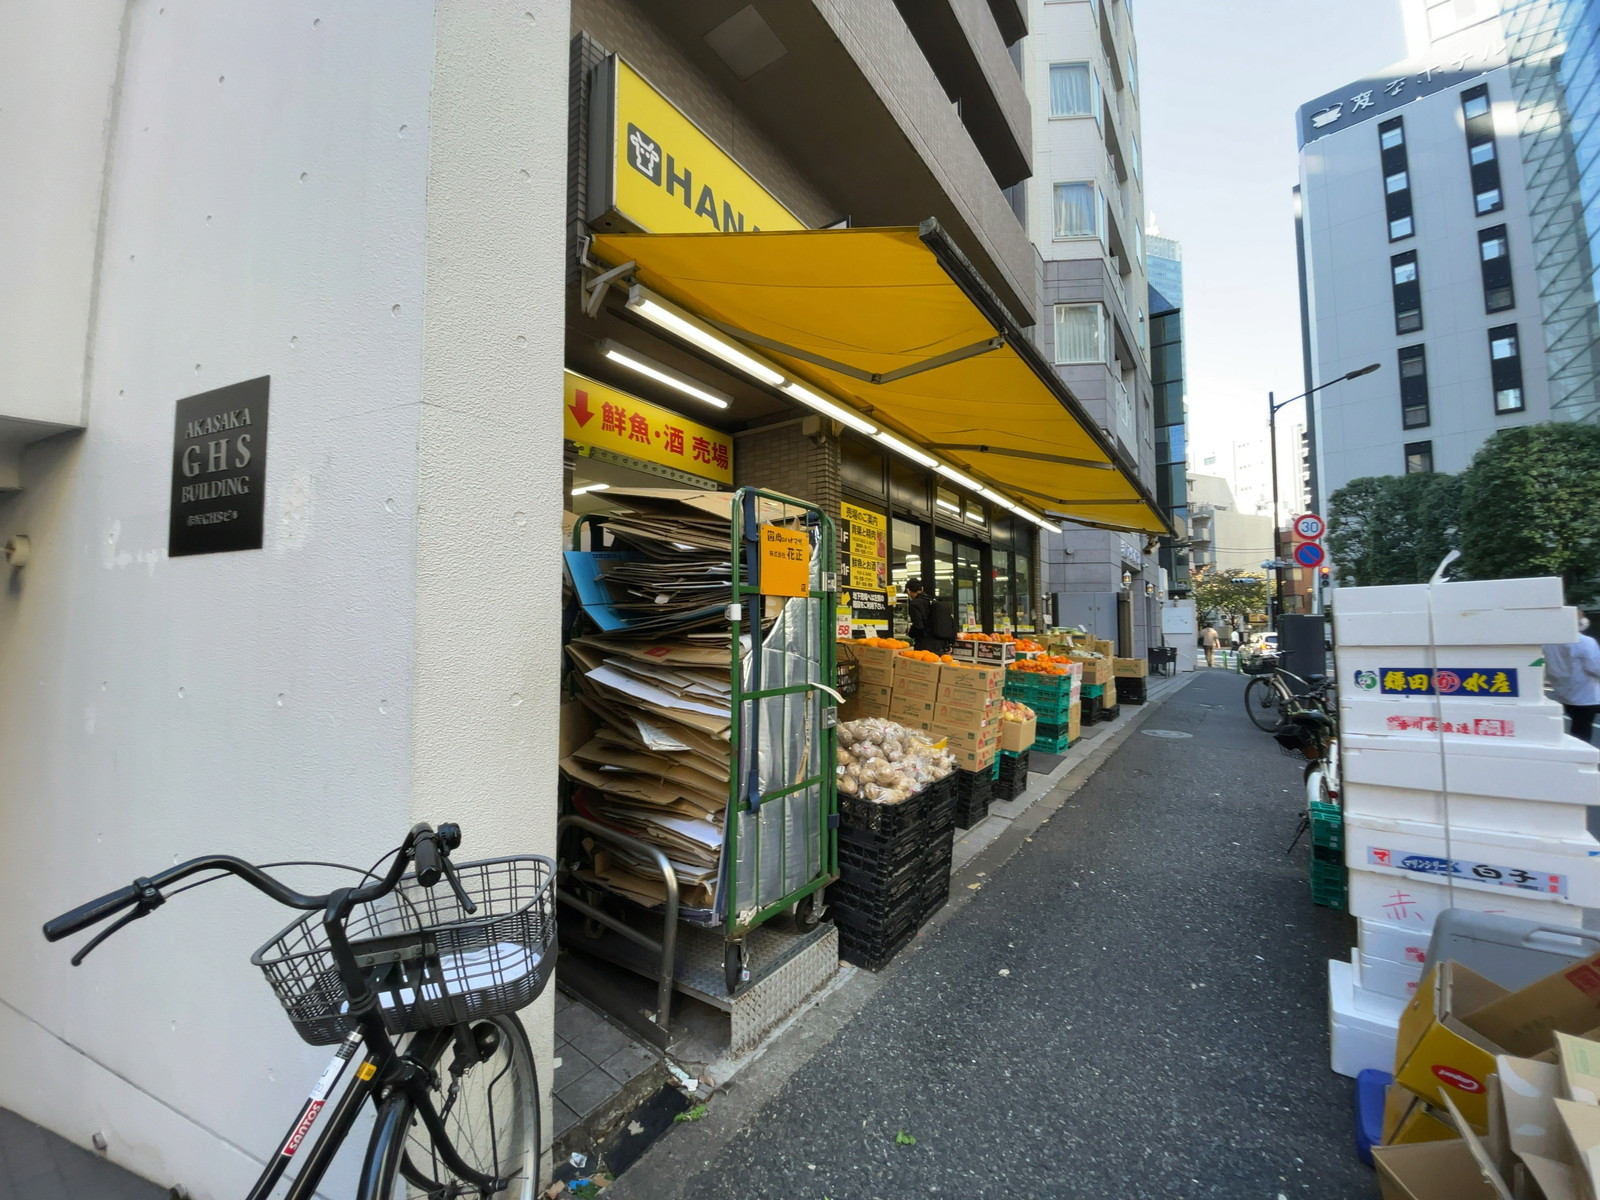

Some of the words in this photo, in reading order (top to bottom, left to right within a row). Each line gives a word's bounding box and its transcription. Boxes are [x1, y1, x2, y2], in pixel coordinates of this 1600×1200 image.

[184, 407, 252, 439] AKASAKA
[181, 475, 249, 503] BUILDING
[1301, 521, 1319, 533] 30
[838, 625, 849, 635] 58
